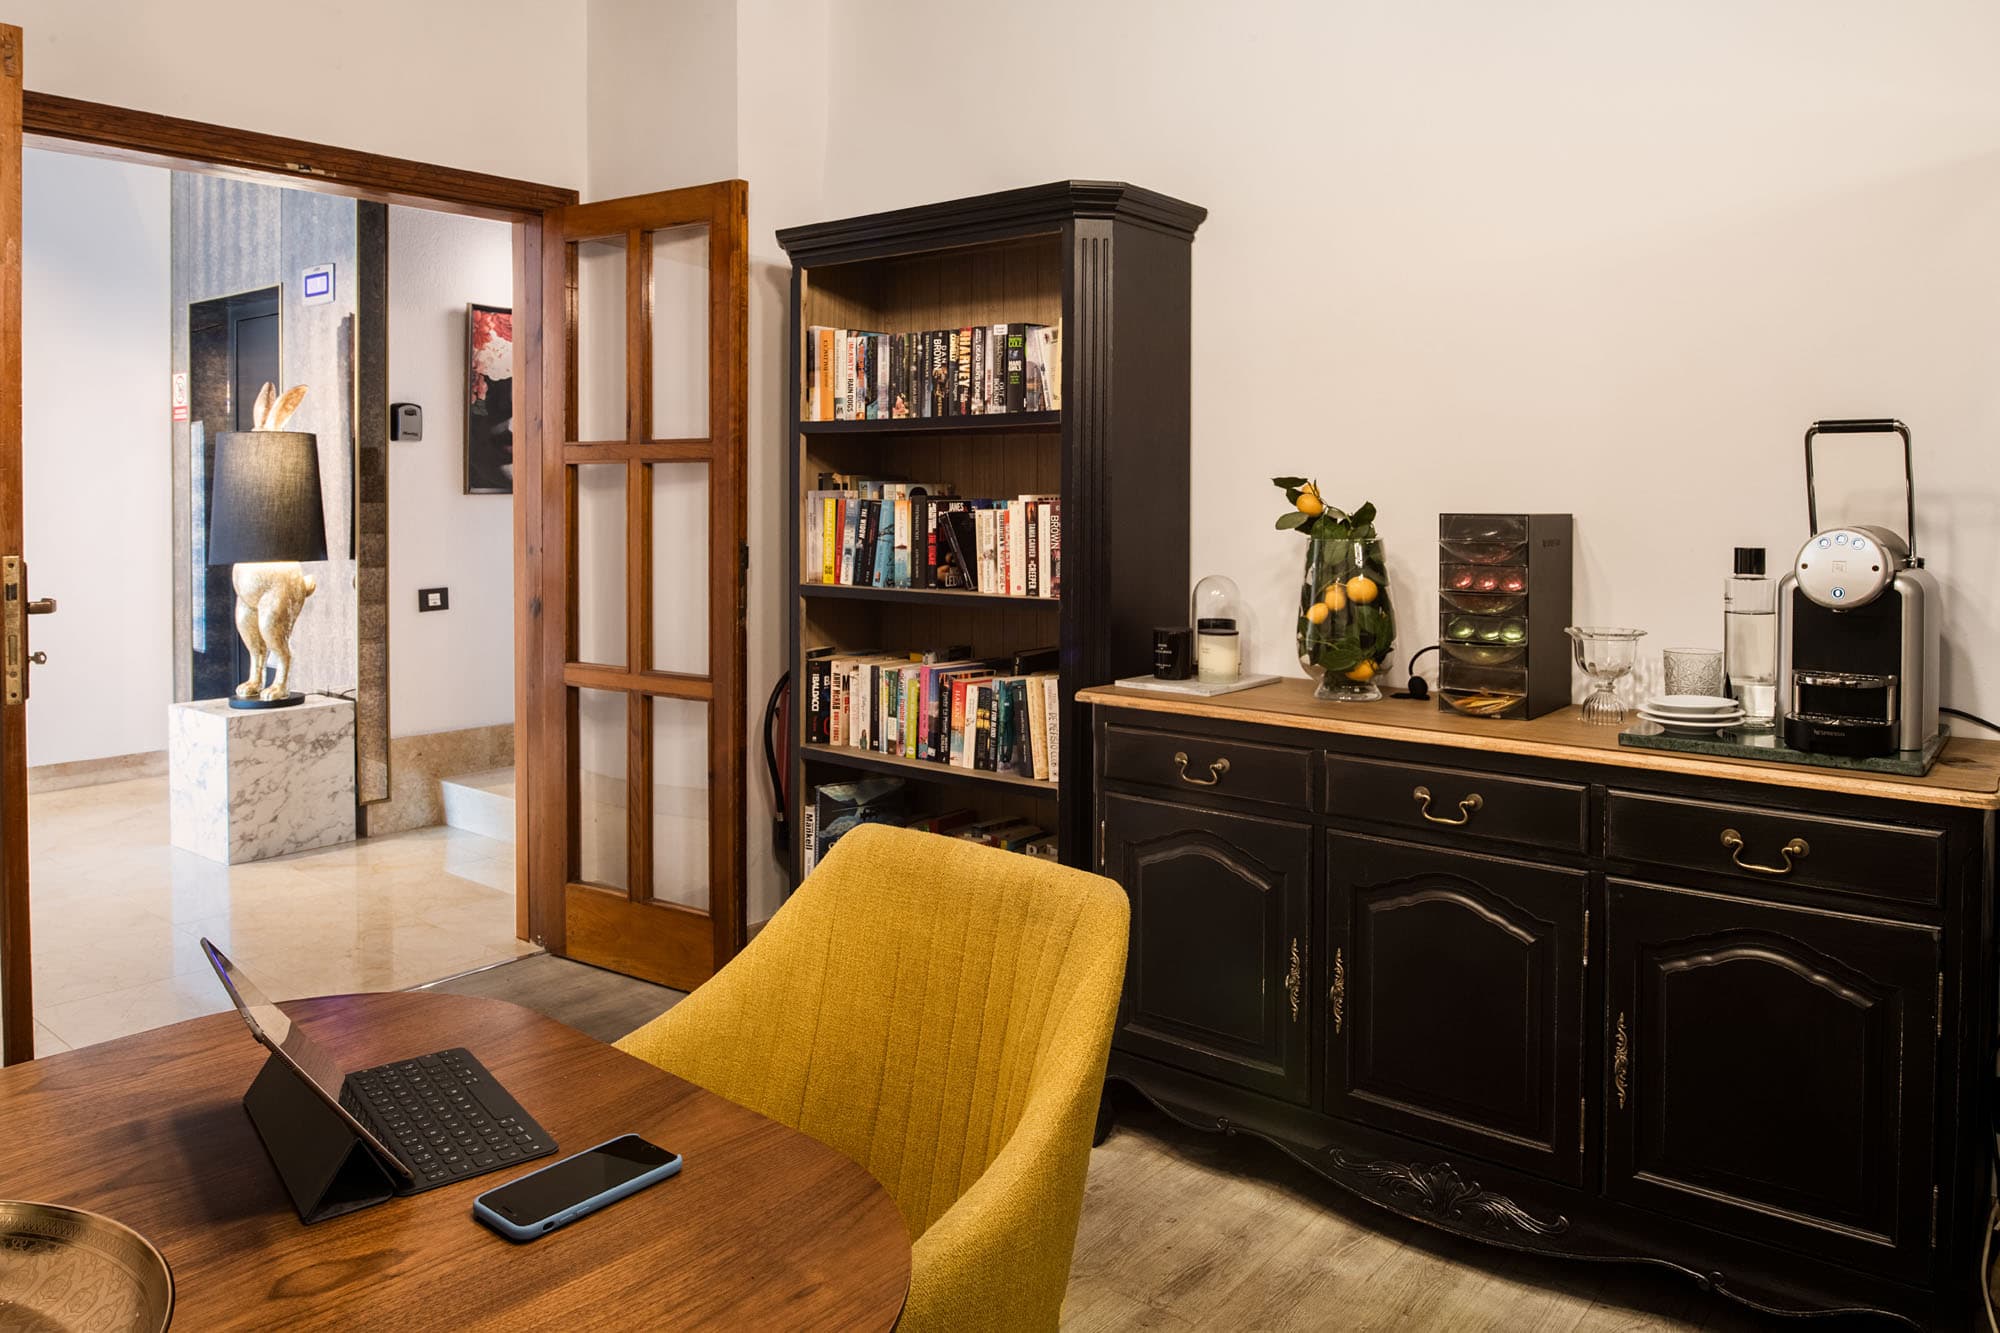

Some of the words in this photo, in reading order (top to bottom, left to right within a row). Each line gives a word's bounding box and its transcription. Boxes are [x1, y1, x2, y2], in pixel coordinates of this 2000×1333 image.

[933, 338, 941, 370] BROWN
[959, 337, 971, 387] HARVEY
[859, 518, 867, 539] WIDOW
[1050, 515, 1059, 550] BROWN
[1028, 563, 1037, 589] CREEPER
[832, 672, 841, 688] ANDY
[805, 813, 813, 851] Mankell
